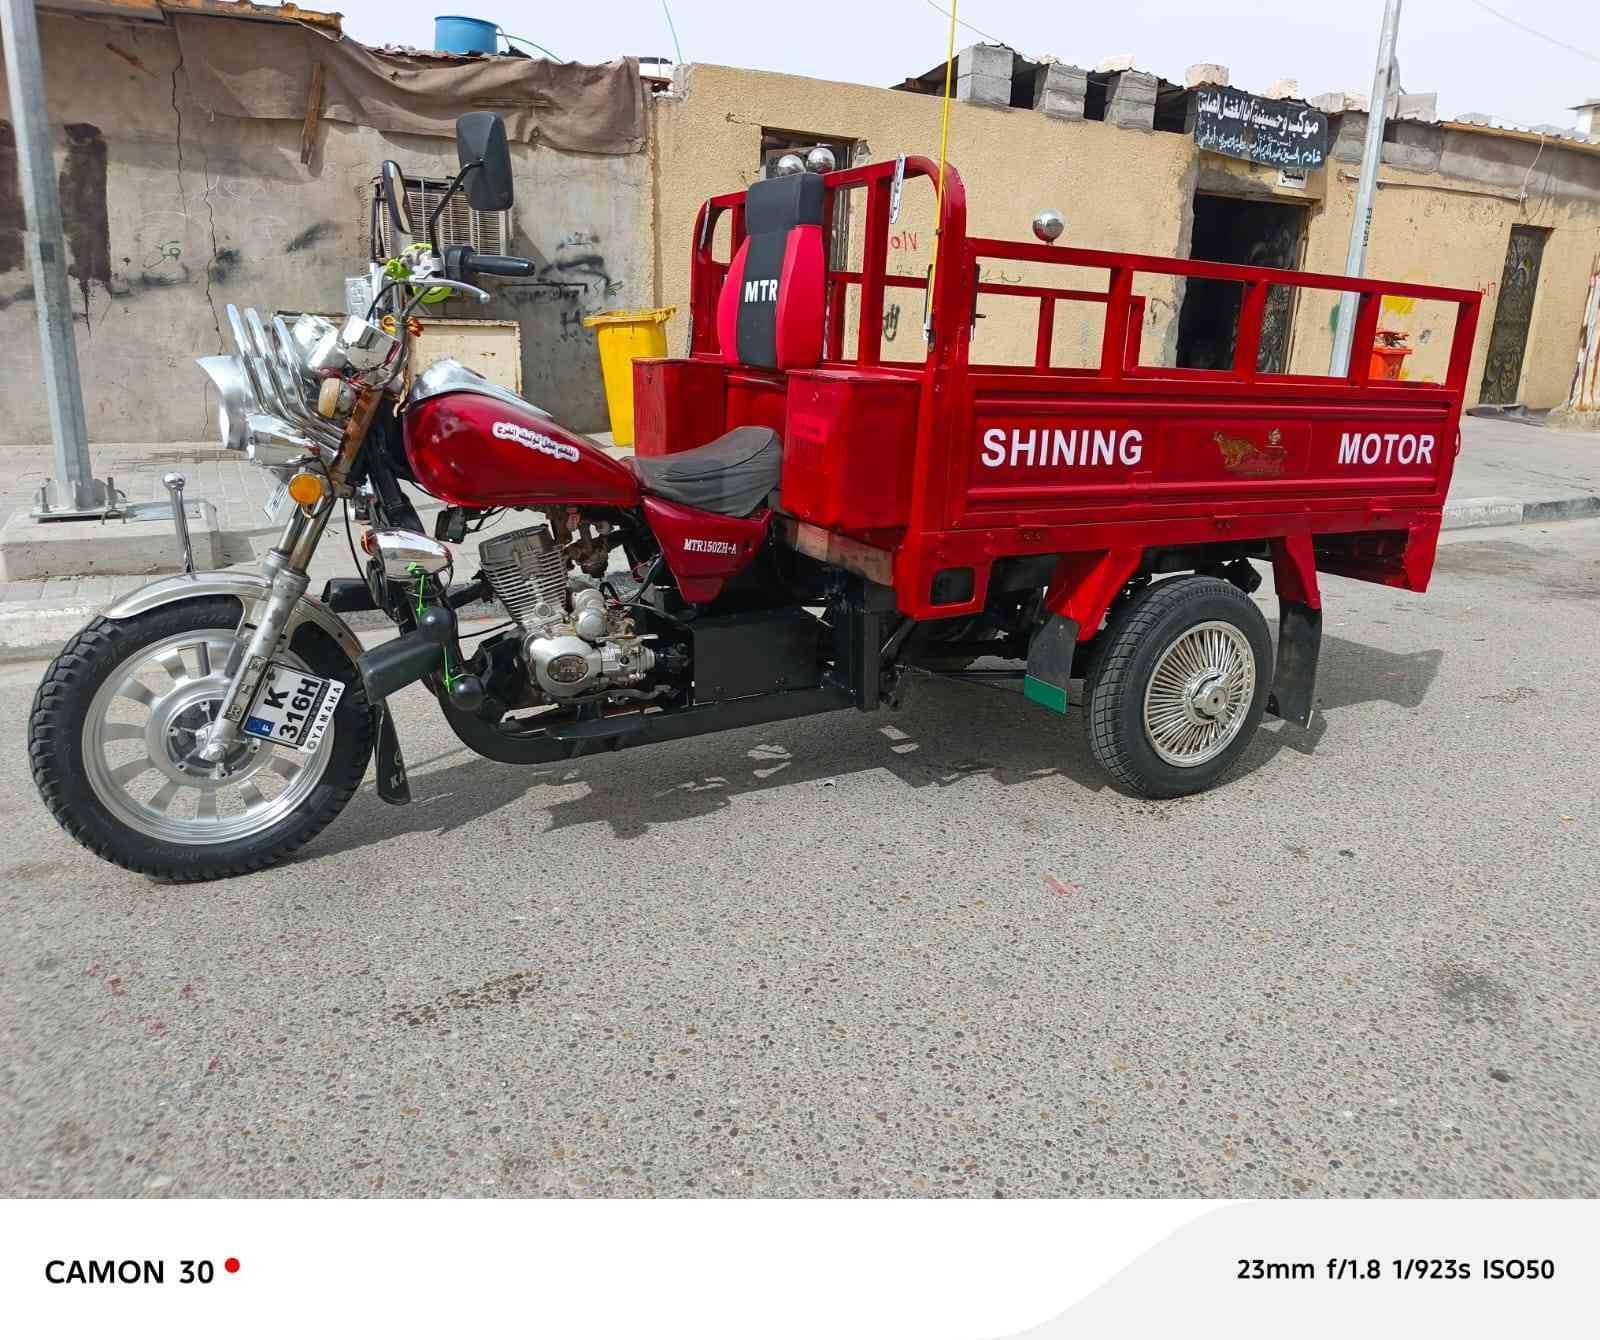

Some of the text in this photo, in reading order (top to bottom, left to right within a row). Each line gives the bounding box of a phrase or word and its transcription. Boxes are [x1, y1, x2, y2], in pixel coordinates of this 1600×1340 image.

[1288, 110, 1319, 139] موكب
[744, 279, 778, 303] MTR
[981, 428, 1435, 467] SHINING MOTOR
[683, 538, 737, 555] MTR150ZH-A
[263, 686, 290, 710] K
[279, 678, 322, 739] 316H
[311, 687, 342, 739] YAMAHA
